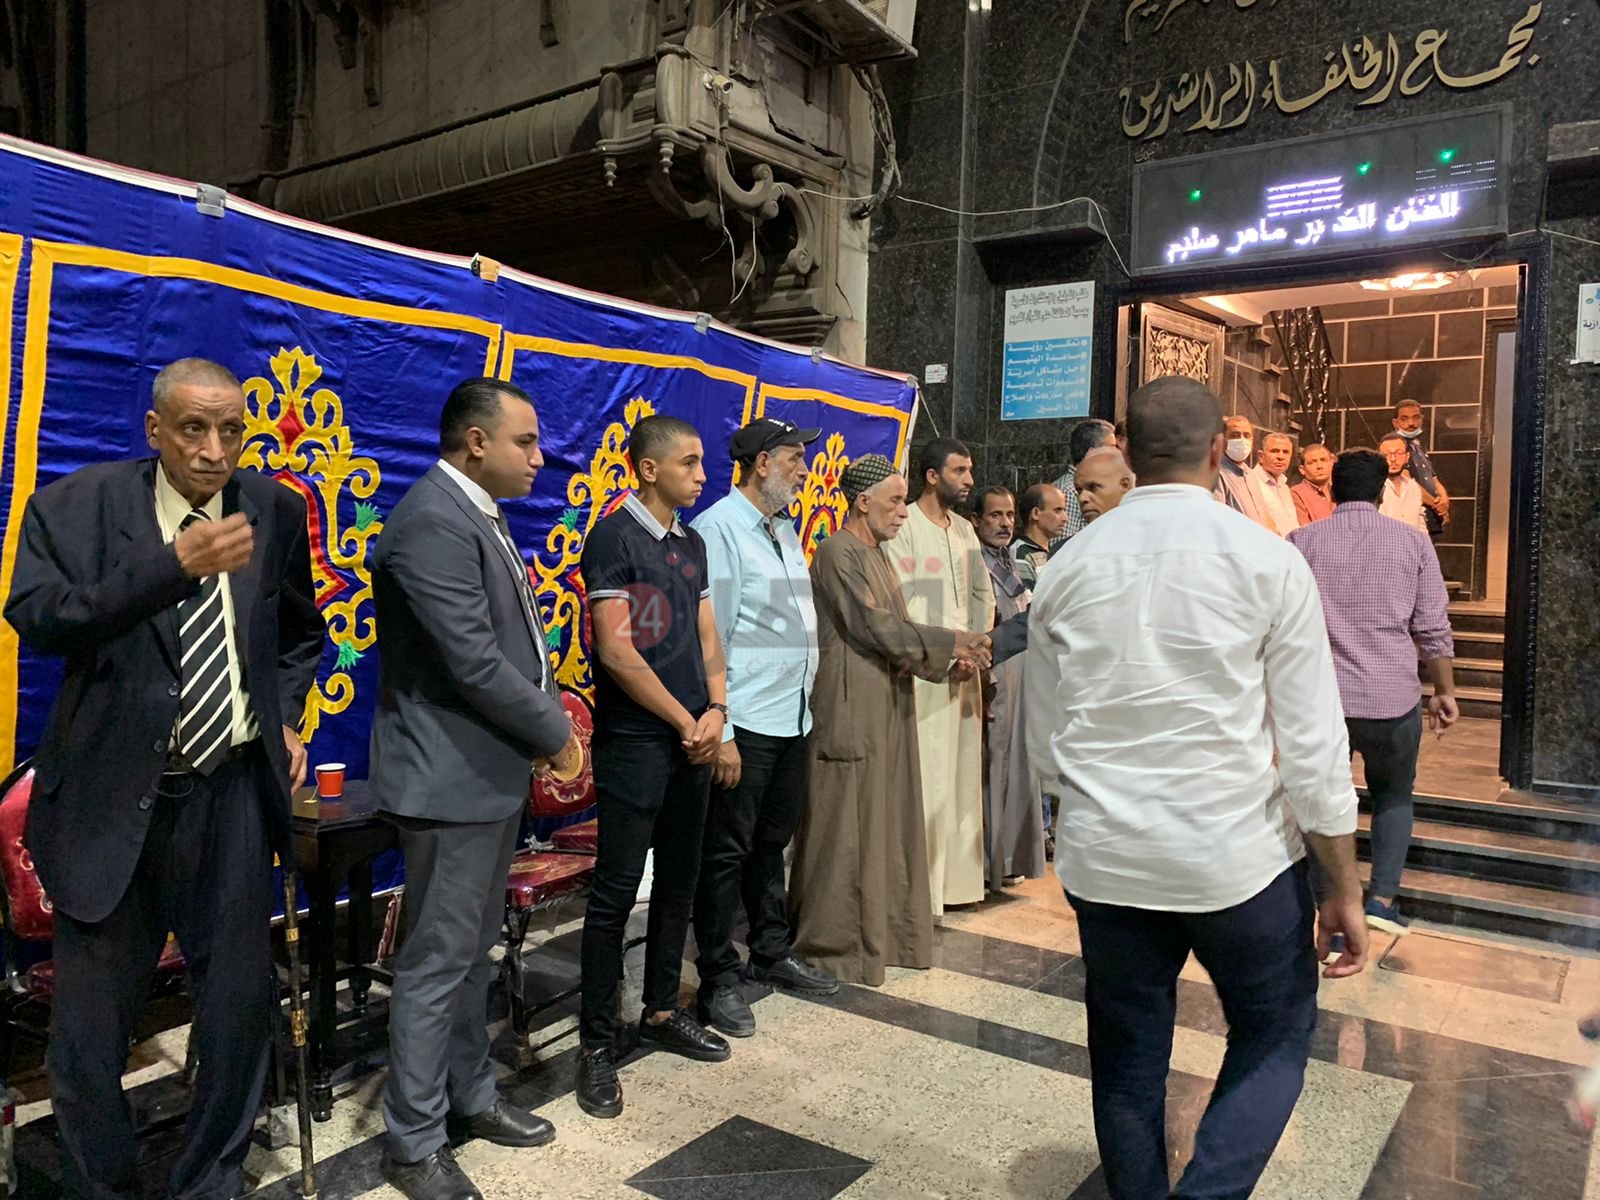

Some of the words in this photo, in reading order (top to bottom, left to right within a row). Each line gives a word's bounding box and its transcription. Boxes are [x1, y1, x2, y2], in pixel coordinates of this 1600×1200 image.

[1119, 60, 1255, 140] الراشدين
[1262, 33, 1399, 112] الخلفاء
[1167, 226, 1220, 263] سليم
[1225, 217, 1288, 254] ماهر
